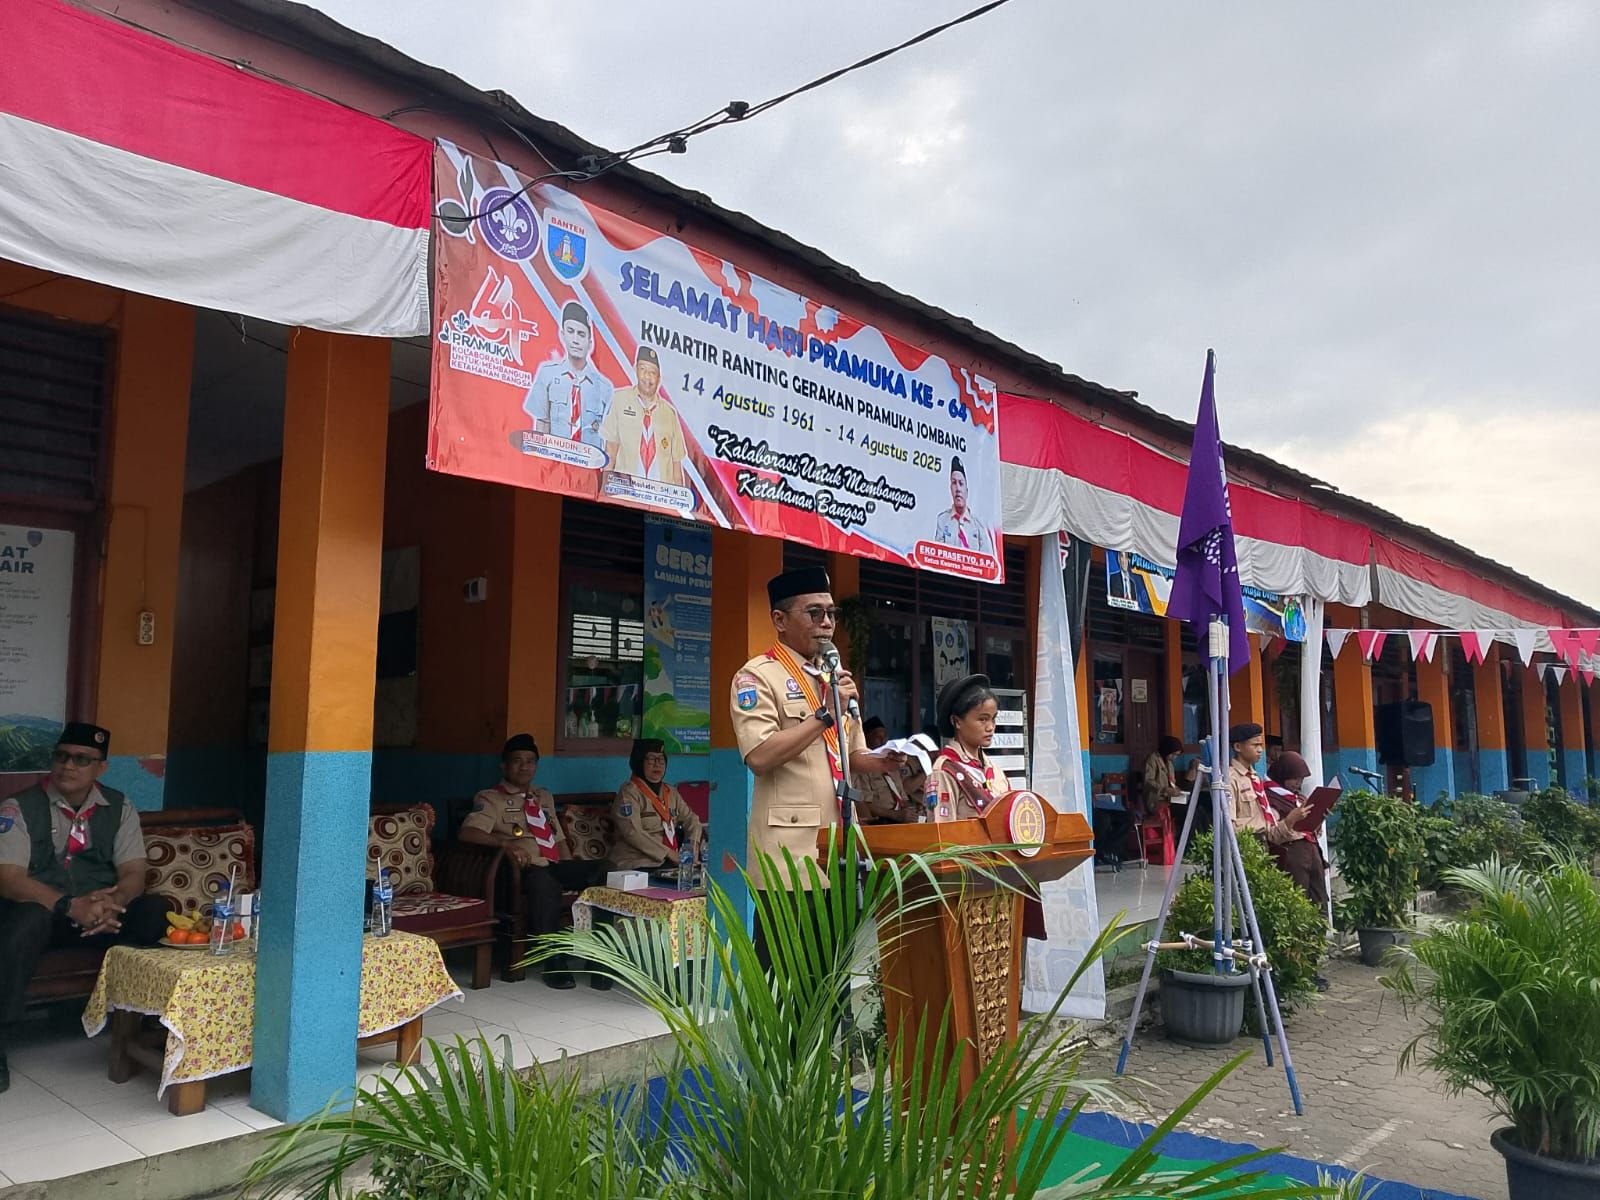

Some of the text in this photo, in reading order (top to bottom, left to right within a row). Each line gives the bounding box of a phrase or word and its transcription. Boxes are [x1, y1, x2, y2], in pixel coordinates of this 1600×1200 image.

[551, 217, 585, 235] BANTEN
[452, 332, 512, 362] PRAMUKA
[452, 345, 502, 365] KOLABORASI
[619, 261, 967, 422] SELAMAT HARI PRAMUKA KE - 64
[451, 360, 532, 387] KETAHANAN BANGSA
[452, 353, 531, 380] UNTUK MEMBANGUN
[641, 320, 967, 452] KWARTIR RANTING GERAKAN PRAMUKA JOMBANG
[681, 372, 704, 396] 14
[712, 385, 775, 418] Agustus
[782, 405, 814, 431] 1961
[838, 425, 855, 445] 14
[860, 433, 908, 462] Agustus
[913, 450, 942, 473] 2025
[737, 472, 813, 509] Ketahanan
[800, 457, 843, 487] Untuk
[843, 469, 915, 509] Membangun
[919, 545, 936, 556] EKO
[937, 549, 979, 566] PRASETYO,
[654, 569, 712, 588] LAWAN PERU
